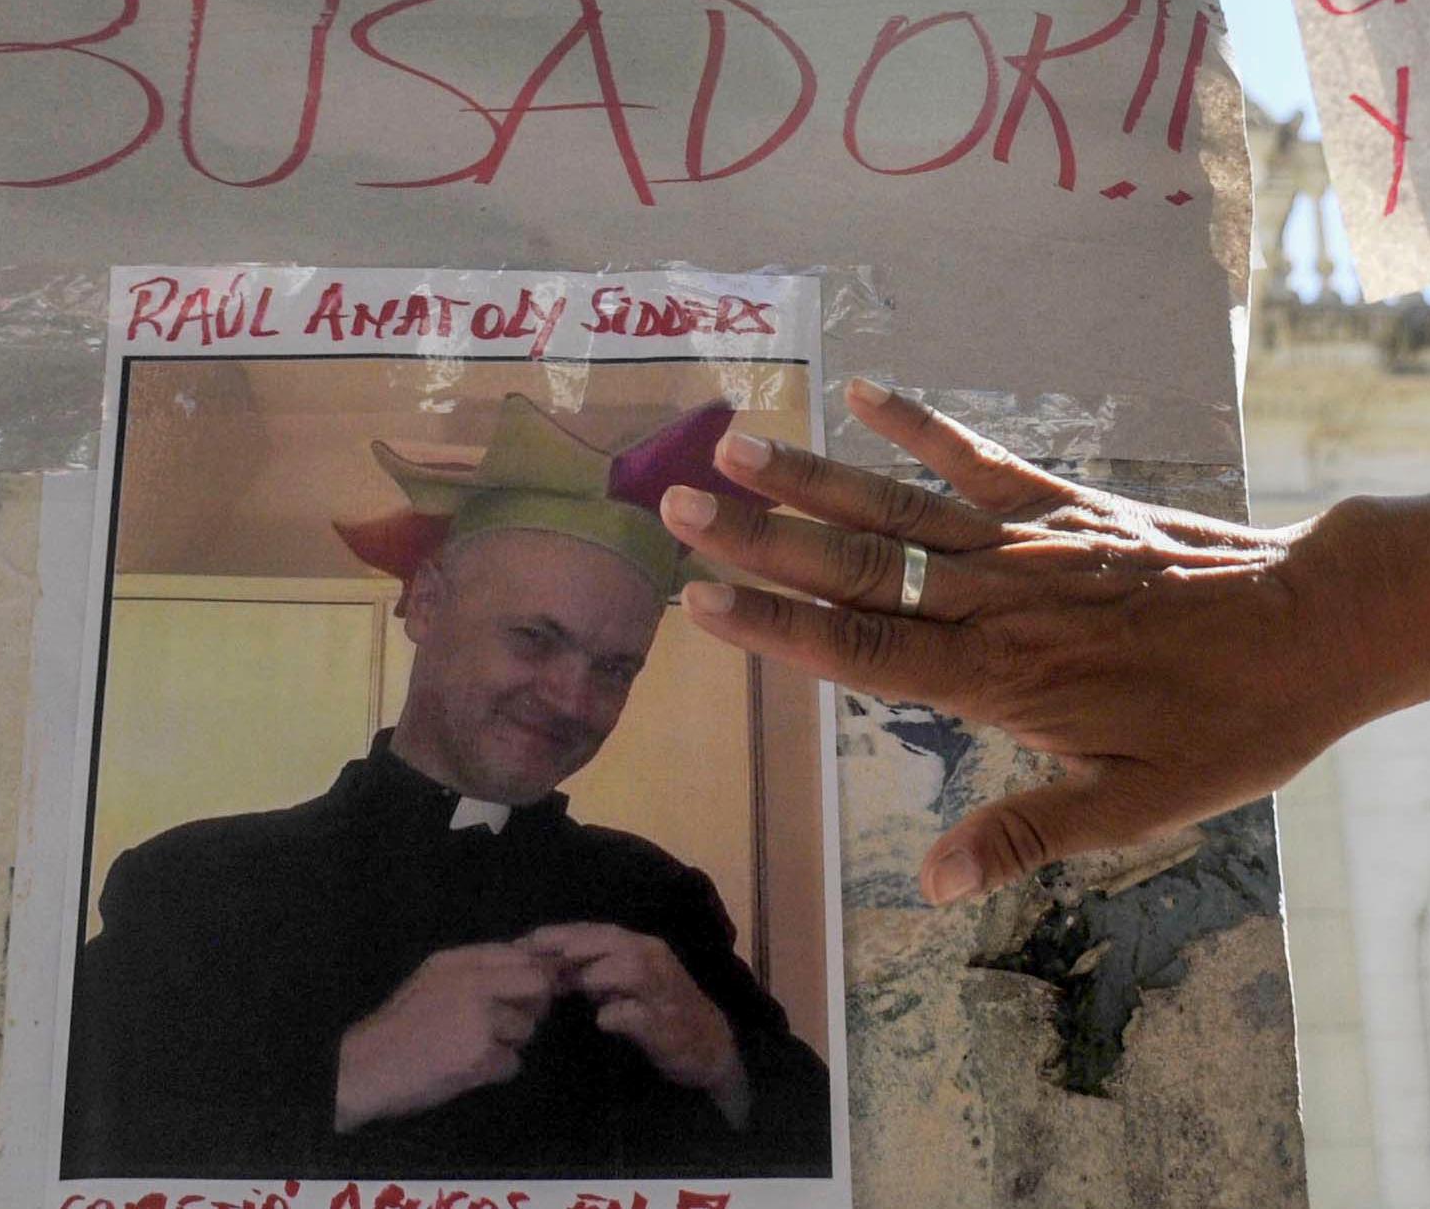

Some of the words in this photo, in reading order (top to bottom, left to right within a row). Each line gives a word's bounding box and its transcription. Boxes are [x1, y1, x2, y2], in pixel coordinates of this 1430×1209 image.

[1350, 66, 1411, 216] Y
[127, 273, 279, 347] RAÚL
[303, 282, 567, 359] ANATOLY
